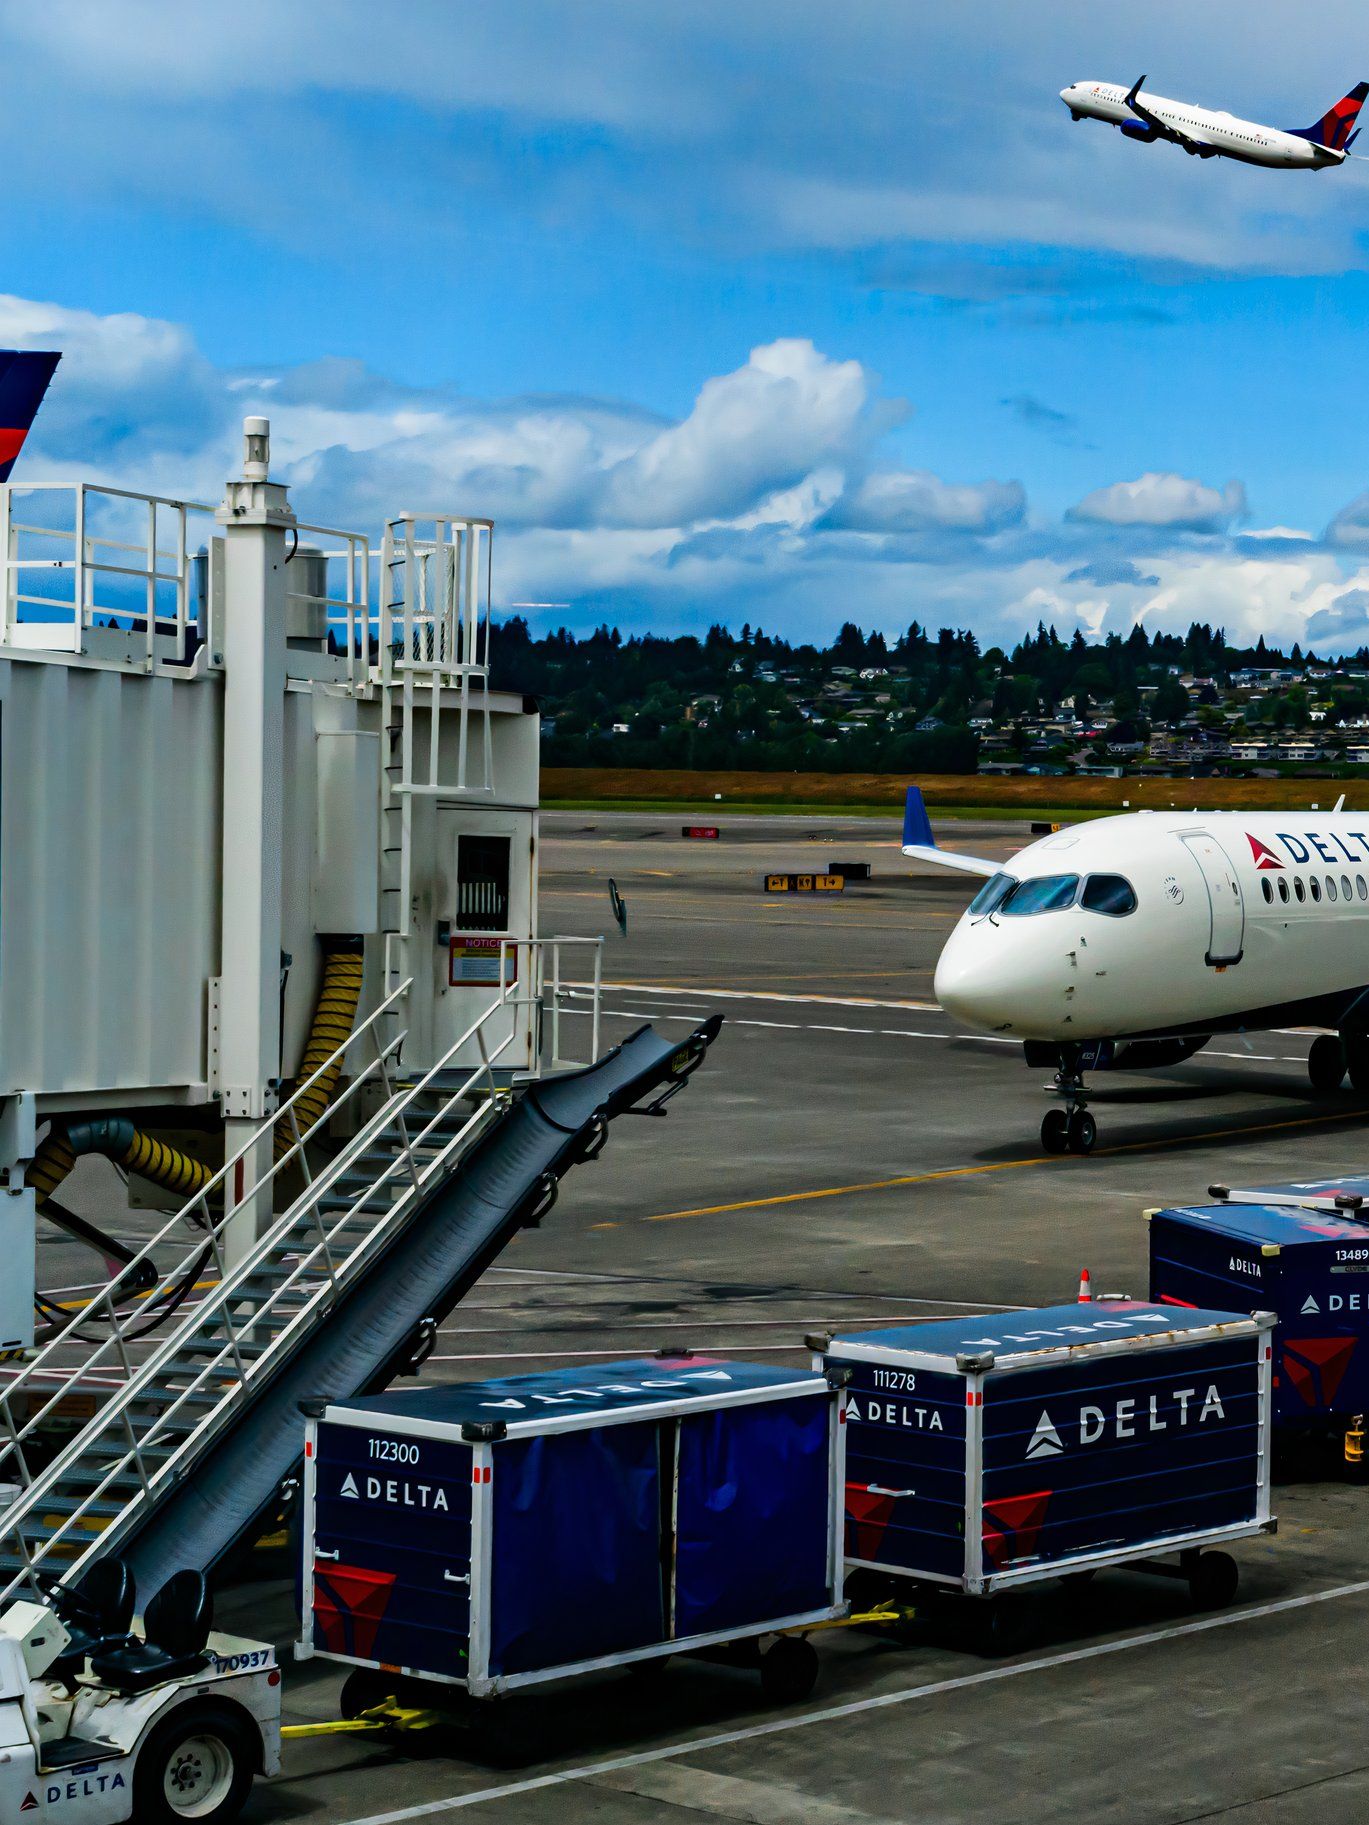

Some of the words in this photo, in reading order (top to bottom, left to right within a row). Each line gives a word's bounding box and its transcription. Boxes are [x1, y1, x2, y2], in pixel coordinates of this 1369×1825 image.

[1236, 1259, 1262, 1278] DELTA
[962, 1321, 1133, 1347] DELTA
[873, 1369, 916, 1392] 111278
[868, 1401, 944, 1432] DELTA
[1079, 1385, 1226, 1445] DELTA
[368, 1438, 420, 1465] 112300
[366, 1476, 449, 1512] DELTA
[216, 1650, 269, 1674] 170937
[47, 1772, 126, 1803] DELTA
